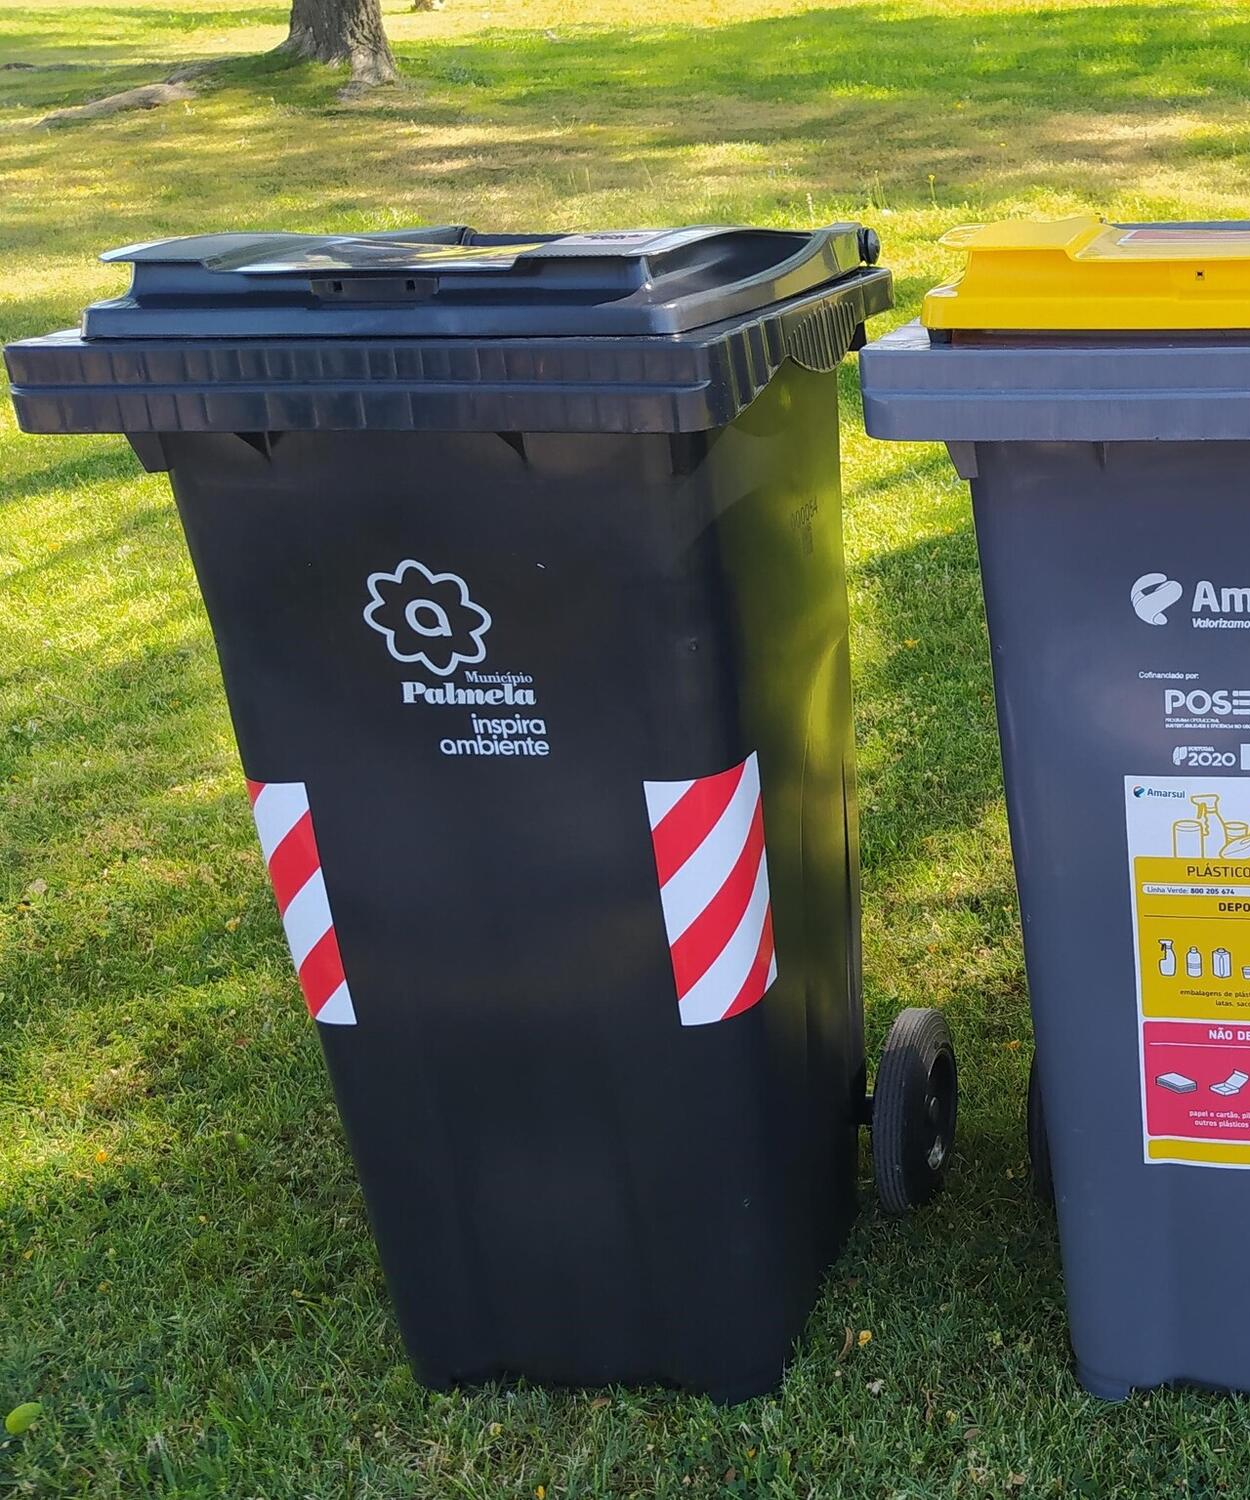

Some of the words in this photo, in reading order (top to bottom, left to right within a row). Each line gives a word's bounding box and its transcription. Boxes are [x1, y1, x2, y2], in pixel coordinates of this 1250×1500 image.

[464, 671, 532, 686] Município
[402, 682, 536, 705] Palmela
[471, 713, 546, 740] inspira
[440, 735, 549, 755] ambiente
[1188, 753, 1236, 766] 2020
[1147, 788, 1185, 798] Amarsul
[1180, 990, 1221, 998] embalagens
[1209, 1027, 1232, 1040] NÃO
[1219, 1119, 1249, 1129] plásticos
